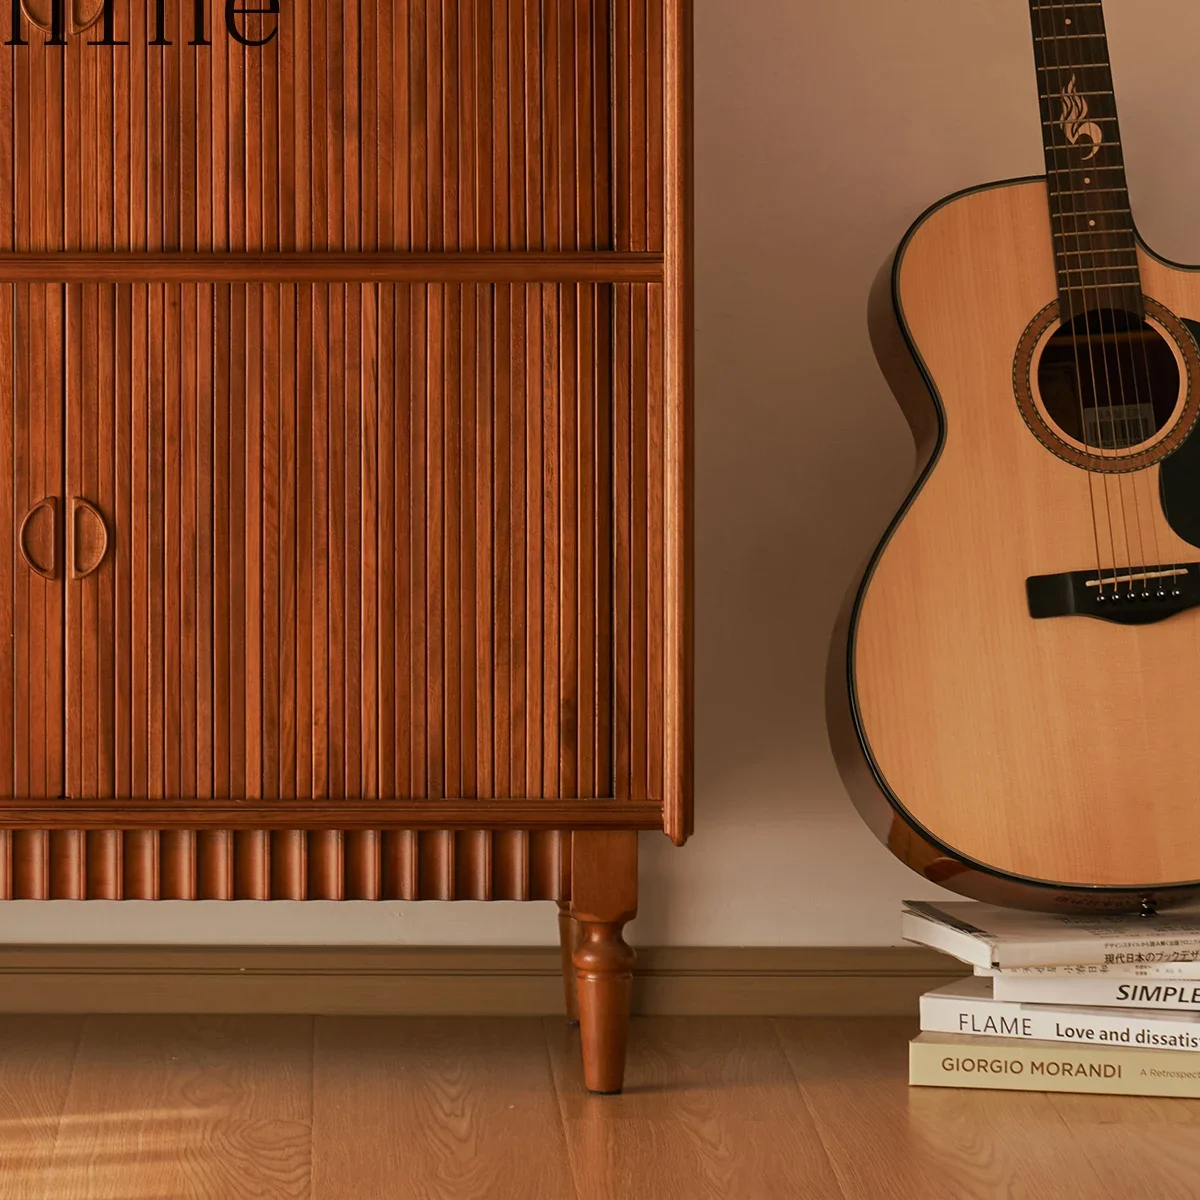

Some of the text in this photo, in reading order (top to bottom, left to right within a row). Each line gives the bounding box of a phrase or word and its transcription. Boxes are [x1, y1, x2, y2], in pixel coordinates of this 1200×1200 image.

[1116, 984, 1200, 1003] SIMPLE
[959, 1013, 1200, 1048] FLAME Love and dissatis
[941, 1057, 1024, 1074] GIORGIO
[1030, 1061, 1122, 1078] MORANDI
[1140, 1068, 1147, 1076] A
